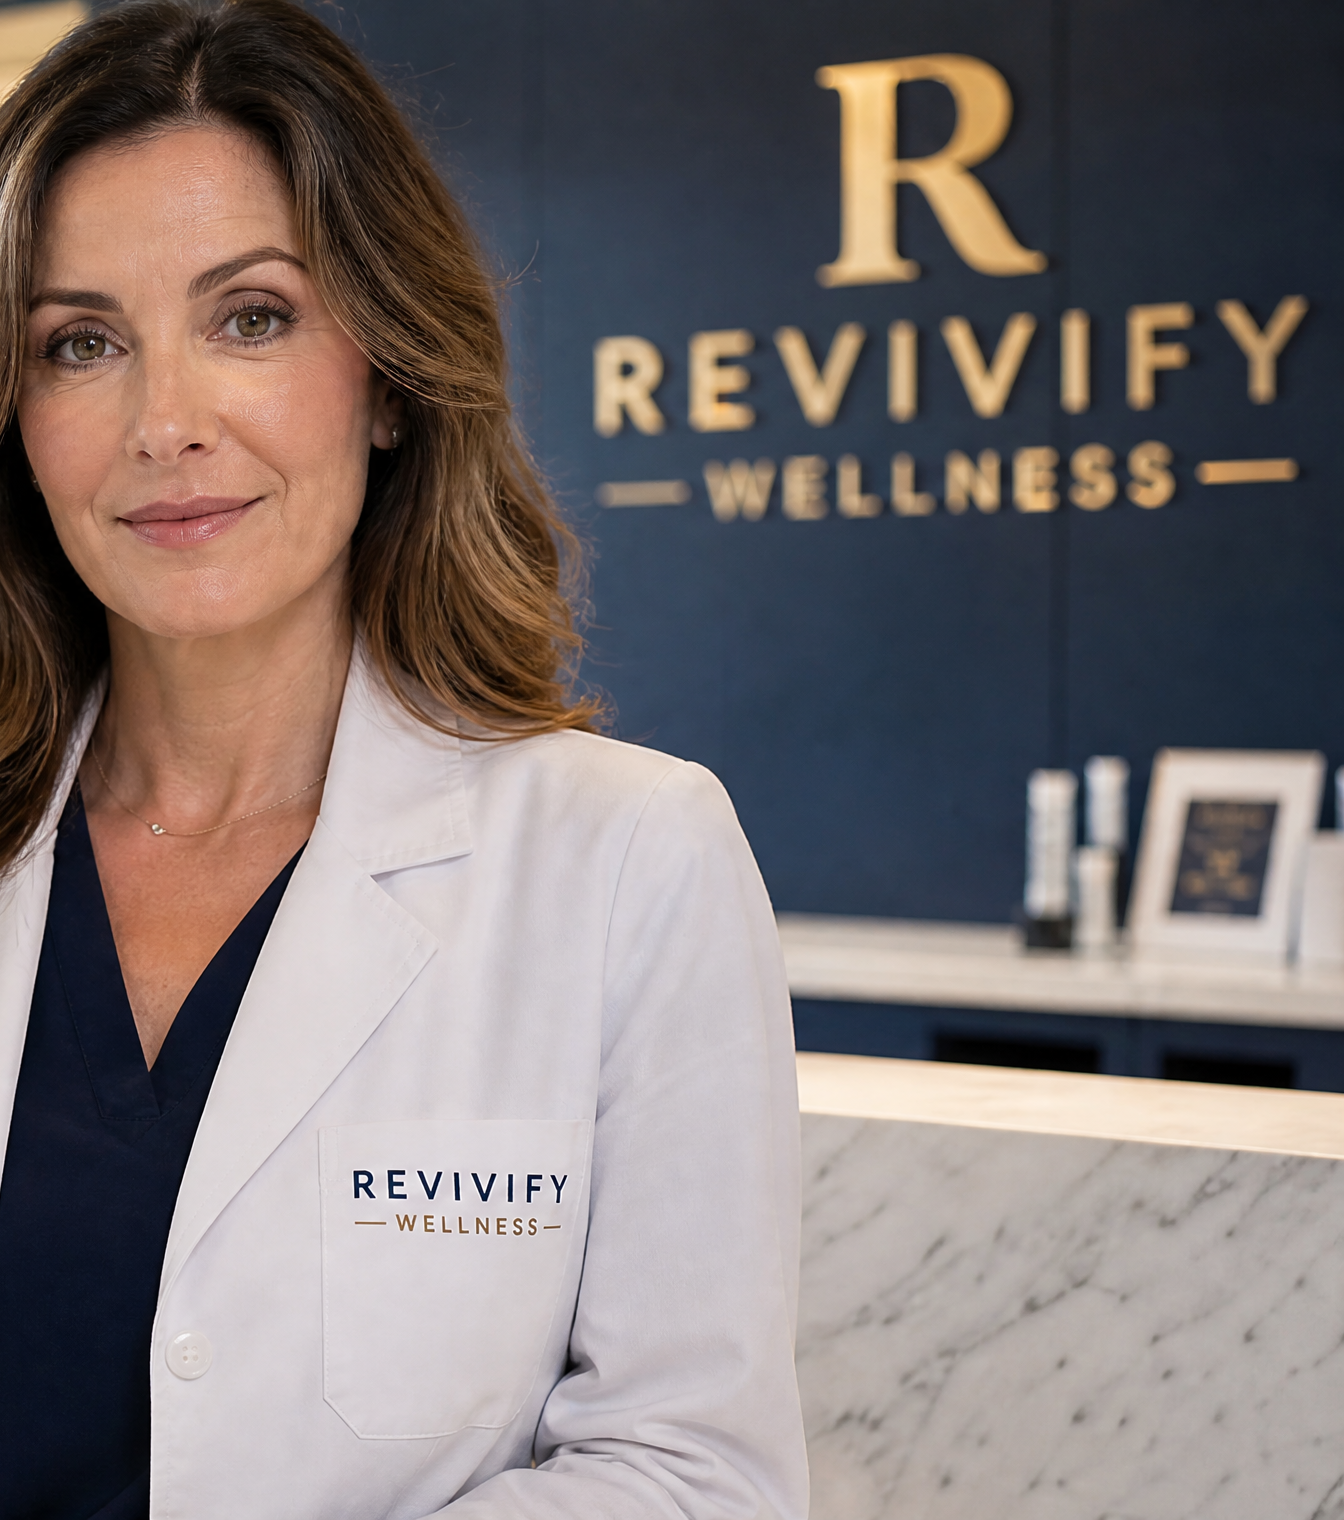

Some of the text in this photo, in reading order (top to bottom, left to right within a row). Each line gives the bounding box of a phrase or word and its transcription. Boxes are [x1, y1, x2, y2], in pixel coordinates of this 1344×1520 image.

[815, 52, 1049, 289] R
[592, 295, 1309, 439] REVIVIFY
[702, 440, 1176, 524] WELLNESS
[352, 1169, 568, 1204] REVIVIFY
[395, 1213, 538, 1236] WELLNESS
